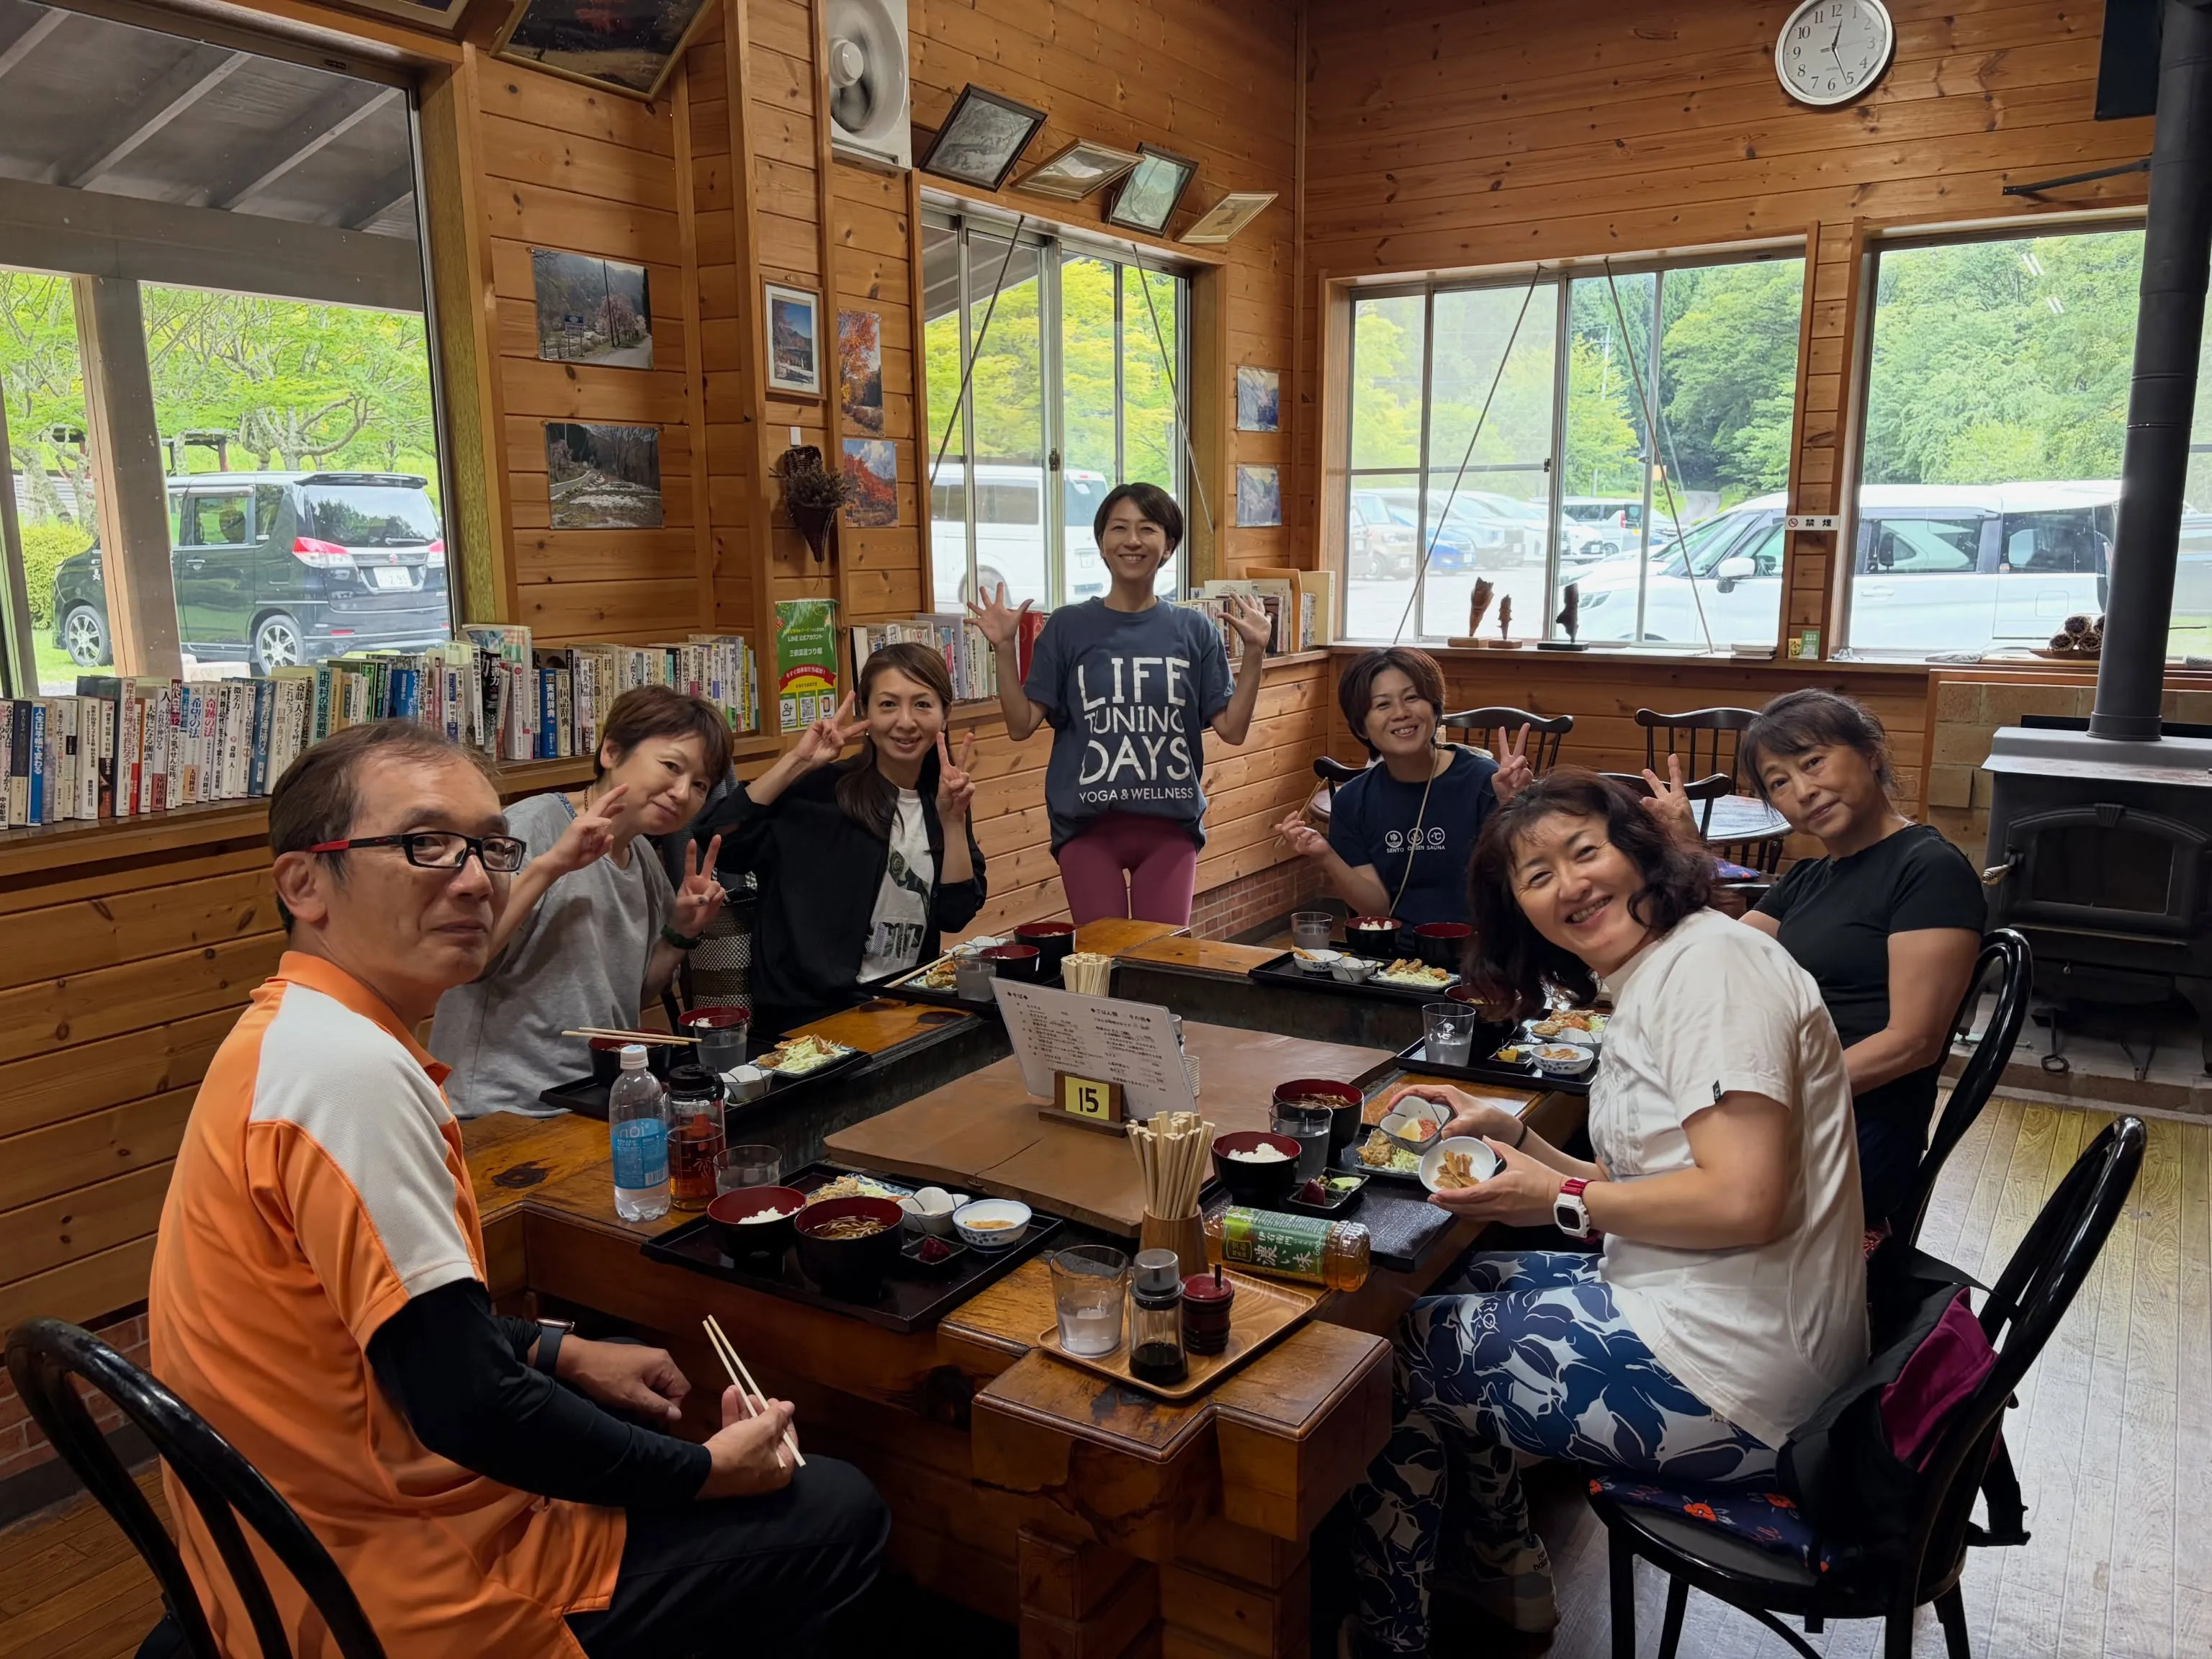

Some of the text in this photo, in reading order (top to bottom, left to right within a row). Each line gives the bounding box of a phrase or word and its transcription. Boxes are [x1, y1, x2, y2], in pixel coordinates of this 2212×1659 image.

[1814, 10, 1824, 24] 11
[1831, 4, 1843, 17] 12
[1852, 6, 1857, 19] 1
[1863, 17, 1871, 30] 2
[1797, 25, 1811, 40] 10
[1867, 37, 1876, 49] 3
[1793, 46, 1801, 60] 9
[1859, 56, 1867, 69] 4
[1797, 64, 1806, 77] 8
[1846, 71, 1854, 84] 5
[1811, 76, 1819, 89] 7
[1827, 78, 1835, 91] 6
[1078, 657, 1190, 711] LIFE
[317, 671, 331, 739] 市町村の経営戦略
[189, 697, 202, 739] 希望の法
[204, 698, 217, 738] 奇跡の法
[1079, 735, 1191, 786] DAYS
[1079, 788, 1193, 804] YOGA & WELLNESS
[1078, 1087, 1100, 1113] 15
[1258, 1230, 1293, 1246] 伊右衛門
[1254, 1244, 1313, 1272] 濃い味
